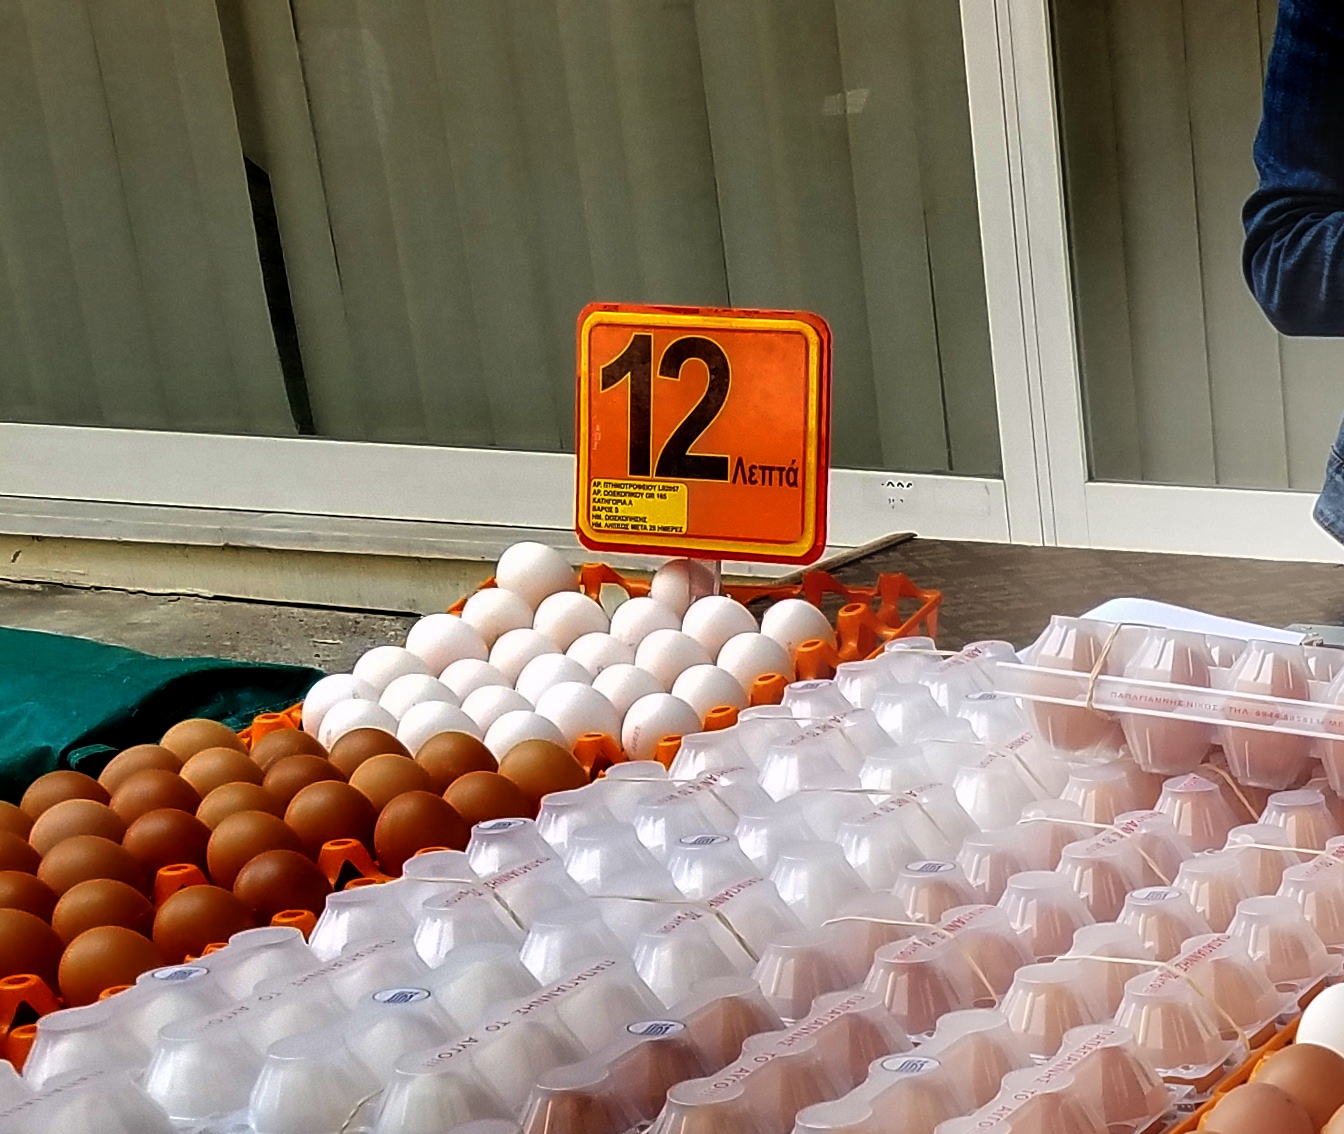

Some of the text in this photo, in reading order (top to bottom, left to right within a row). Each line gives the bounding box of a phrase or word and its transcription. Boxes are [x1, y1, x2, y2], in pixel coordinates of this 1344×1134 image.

[601, 332, 731, 482] 12
[732, 456, 799, 488] Λεπτά
[1110, 691, 1184, 708] ΠΑΠΑΓΙΑΝΝΗΣ
[1187, 701, 1218, 712] ΝΙΚΟΣ
[753, 1052, 777, 1063] ΤΟ
